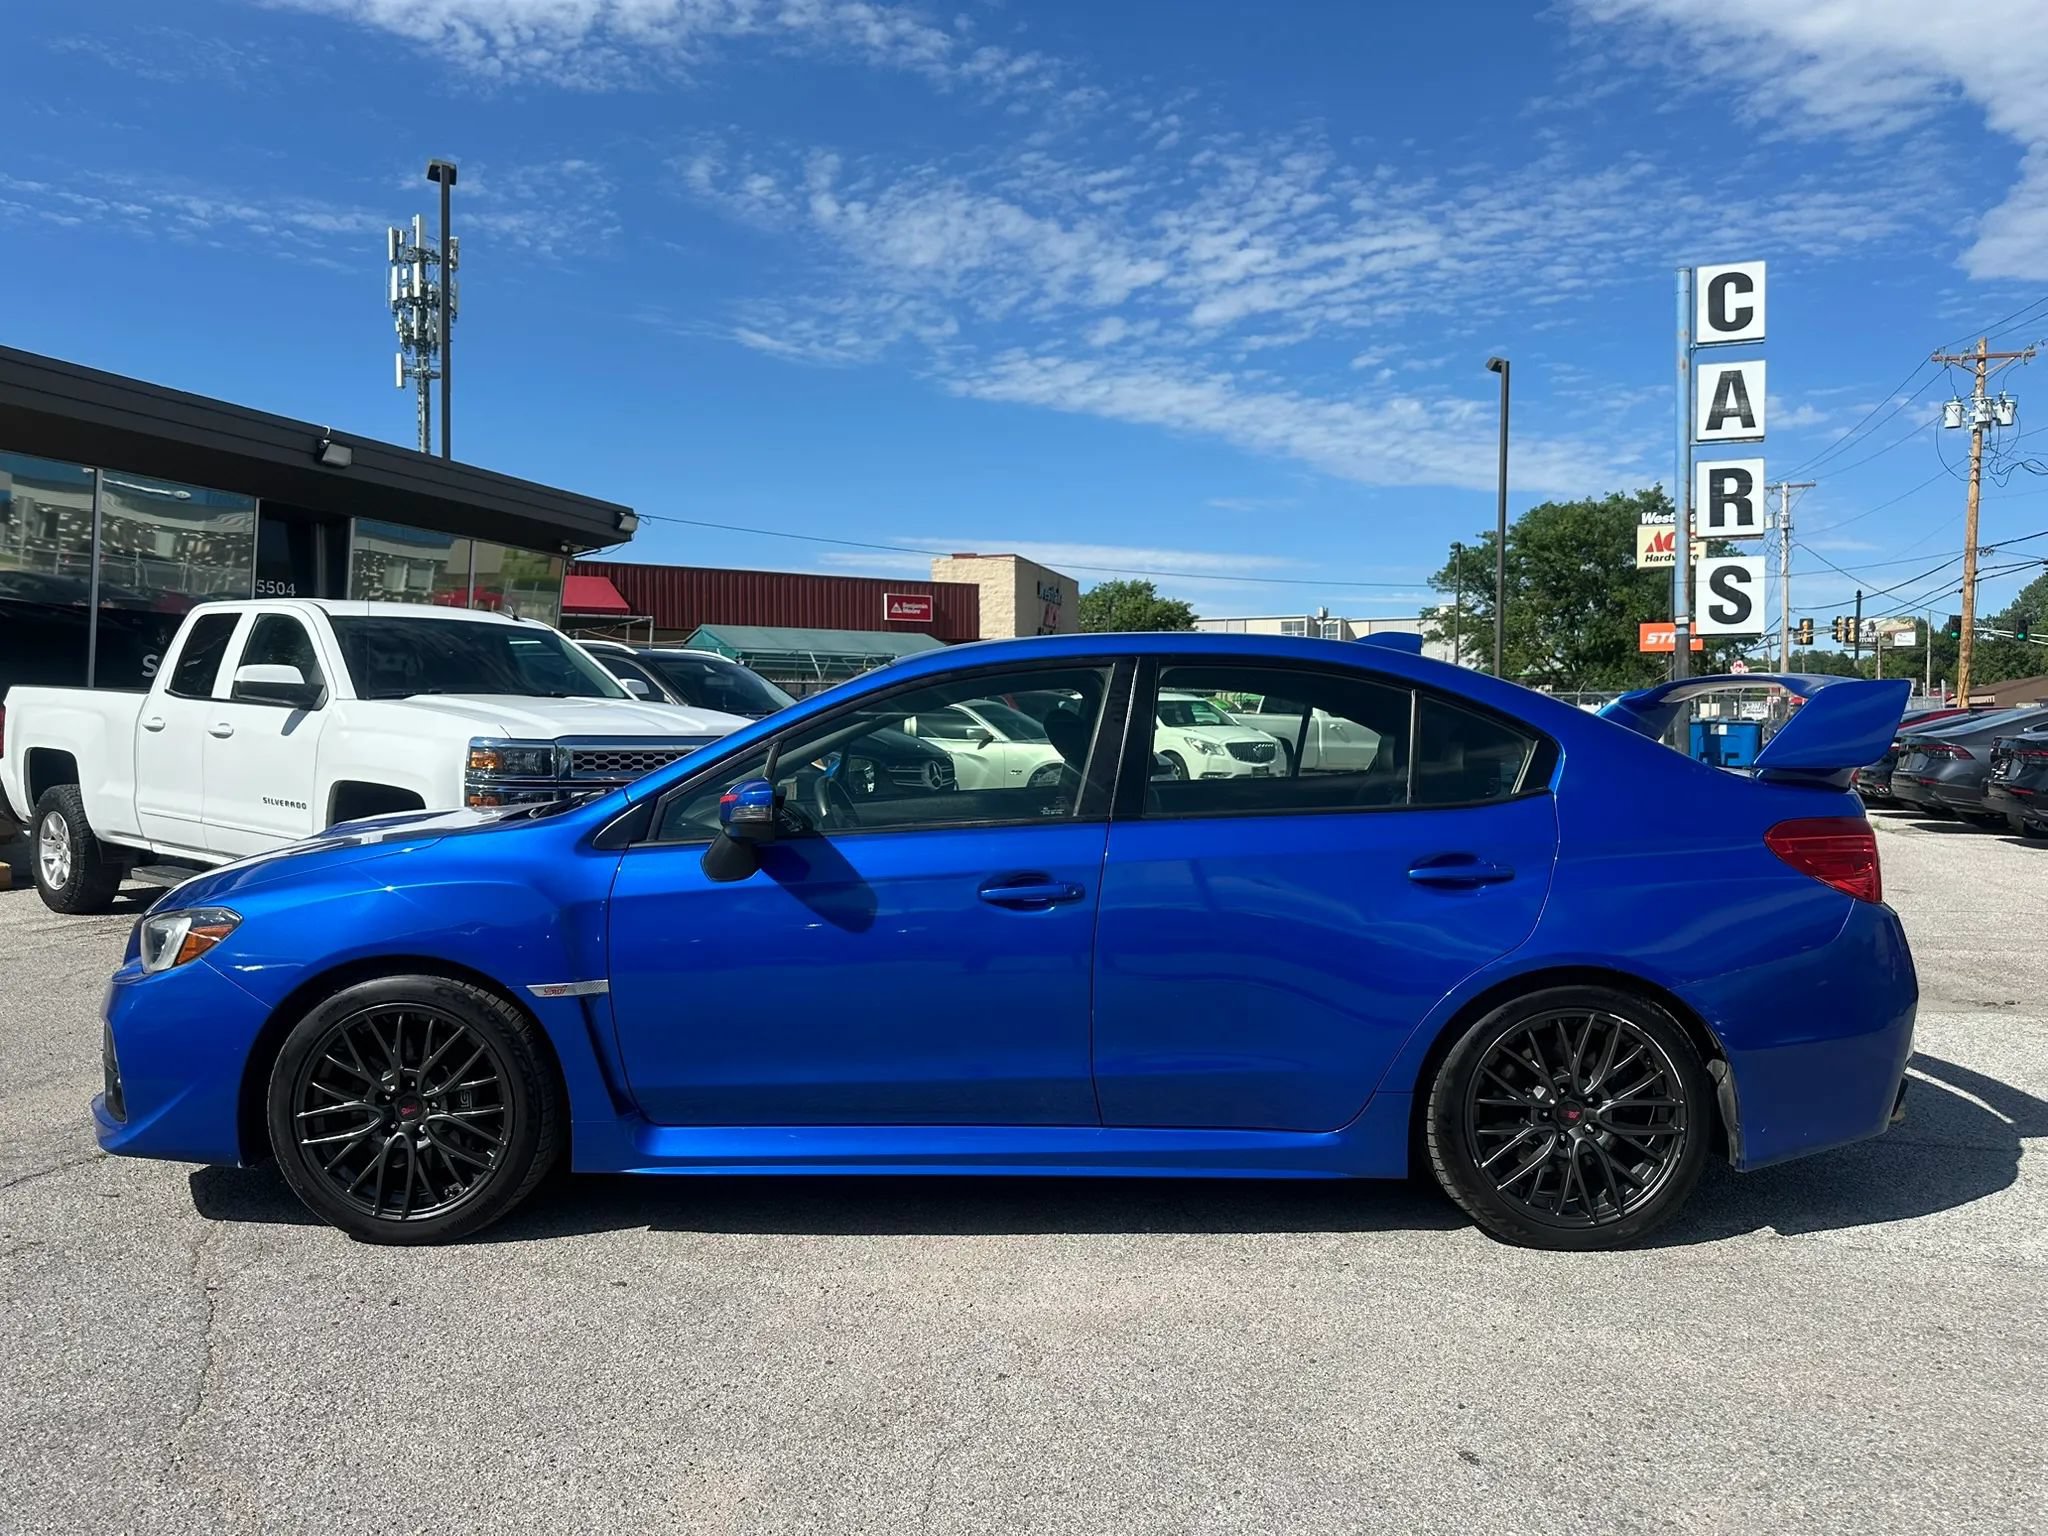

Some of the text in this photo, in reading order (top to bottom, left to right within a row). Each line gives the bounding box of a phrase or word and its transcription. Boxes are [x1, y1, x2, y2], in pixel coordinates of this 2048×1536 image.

[1705, 271, 1756, 625] CARS
[255, 579, 297, 597] 5504
[262, 796, 307, 810] SILVERADO
